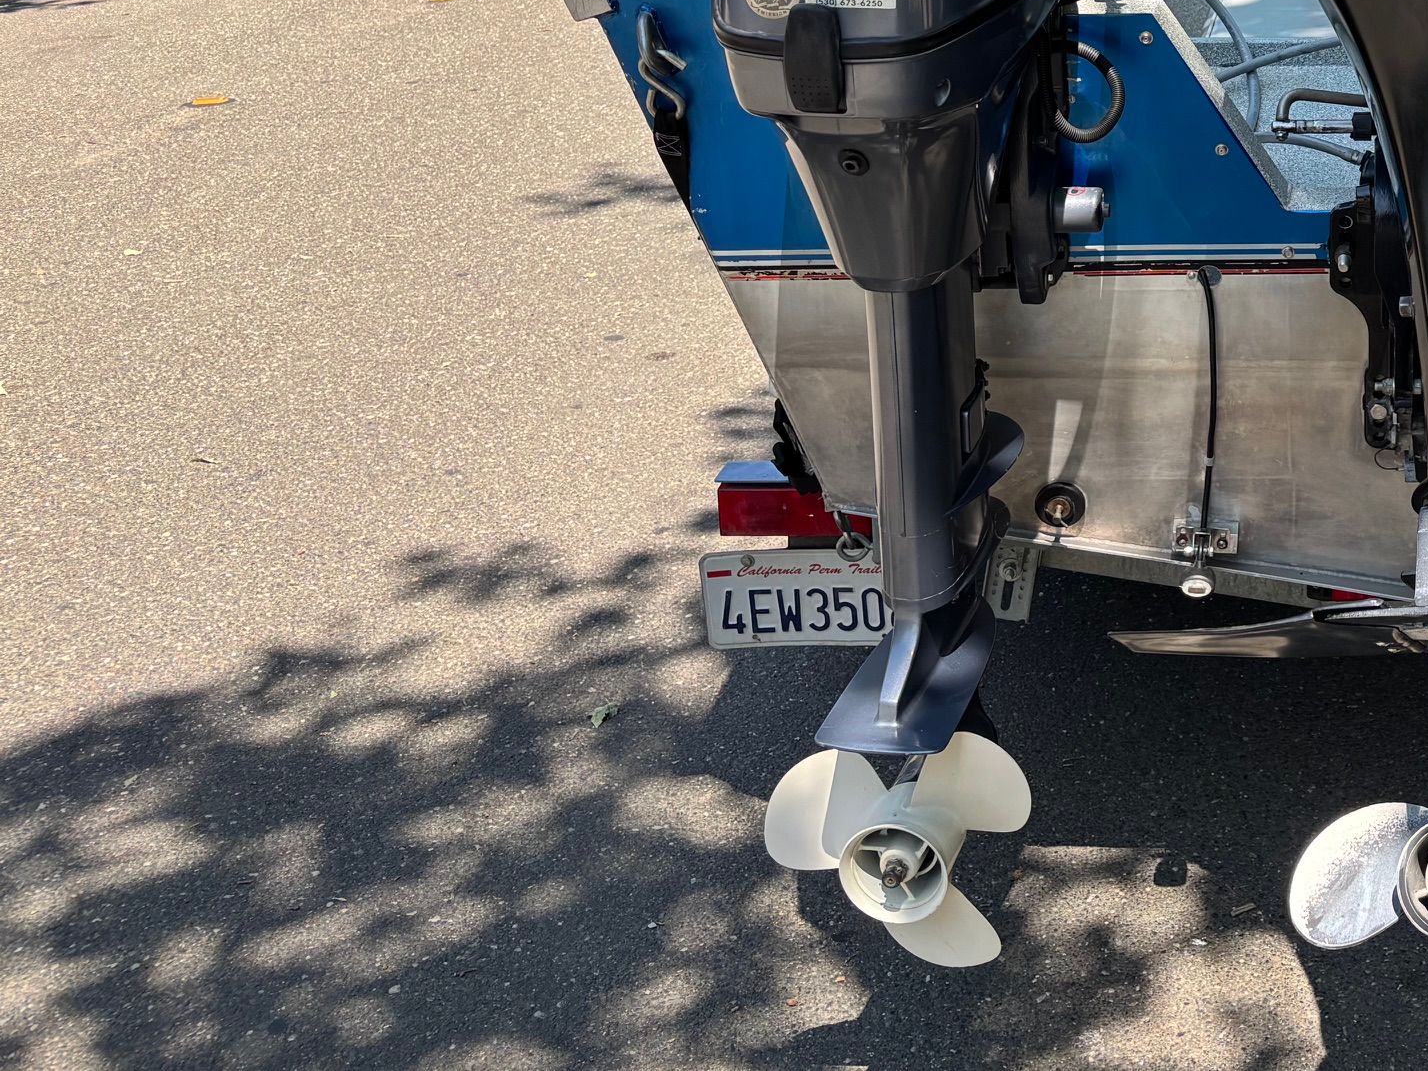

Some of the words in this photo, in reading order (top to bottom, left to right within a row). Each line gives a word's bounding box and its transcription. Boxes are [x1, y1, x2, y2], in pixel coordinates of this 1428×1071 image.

[737, 565, 802, 578] California
[808, 563, 843, 575] Perm
[722, 587, 895, 634] 4EW350
